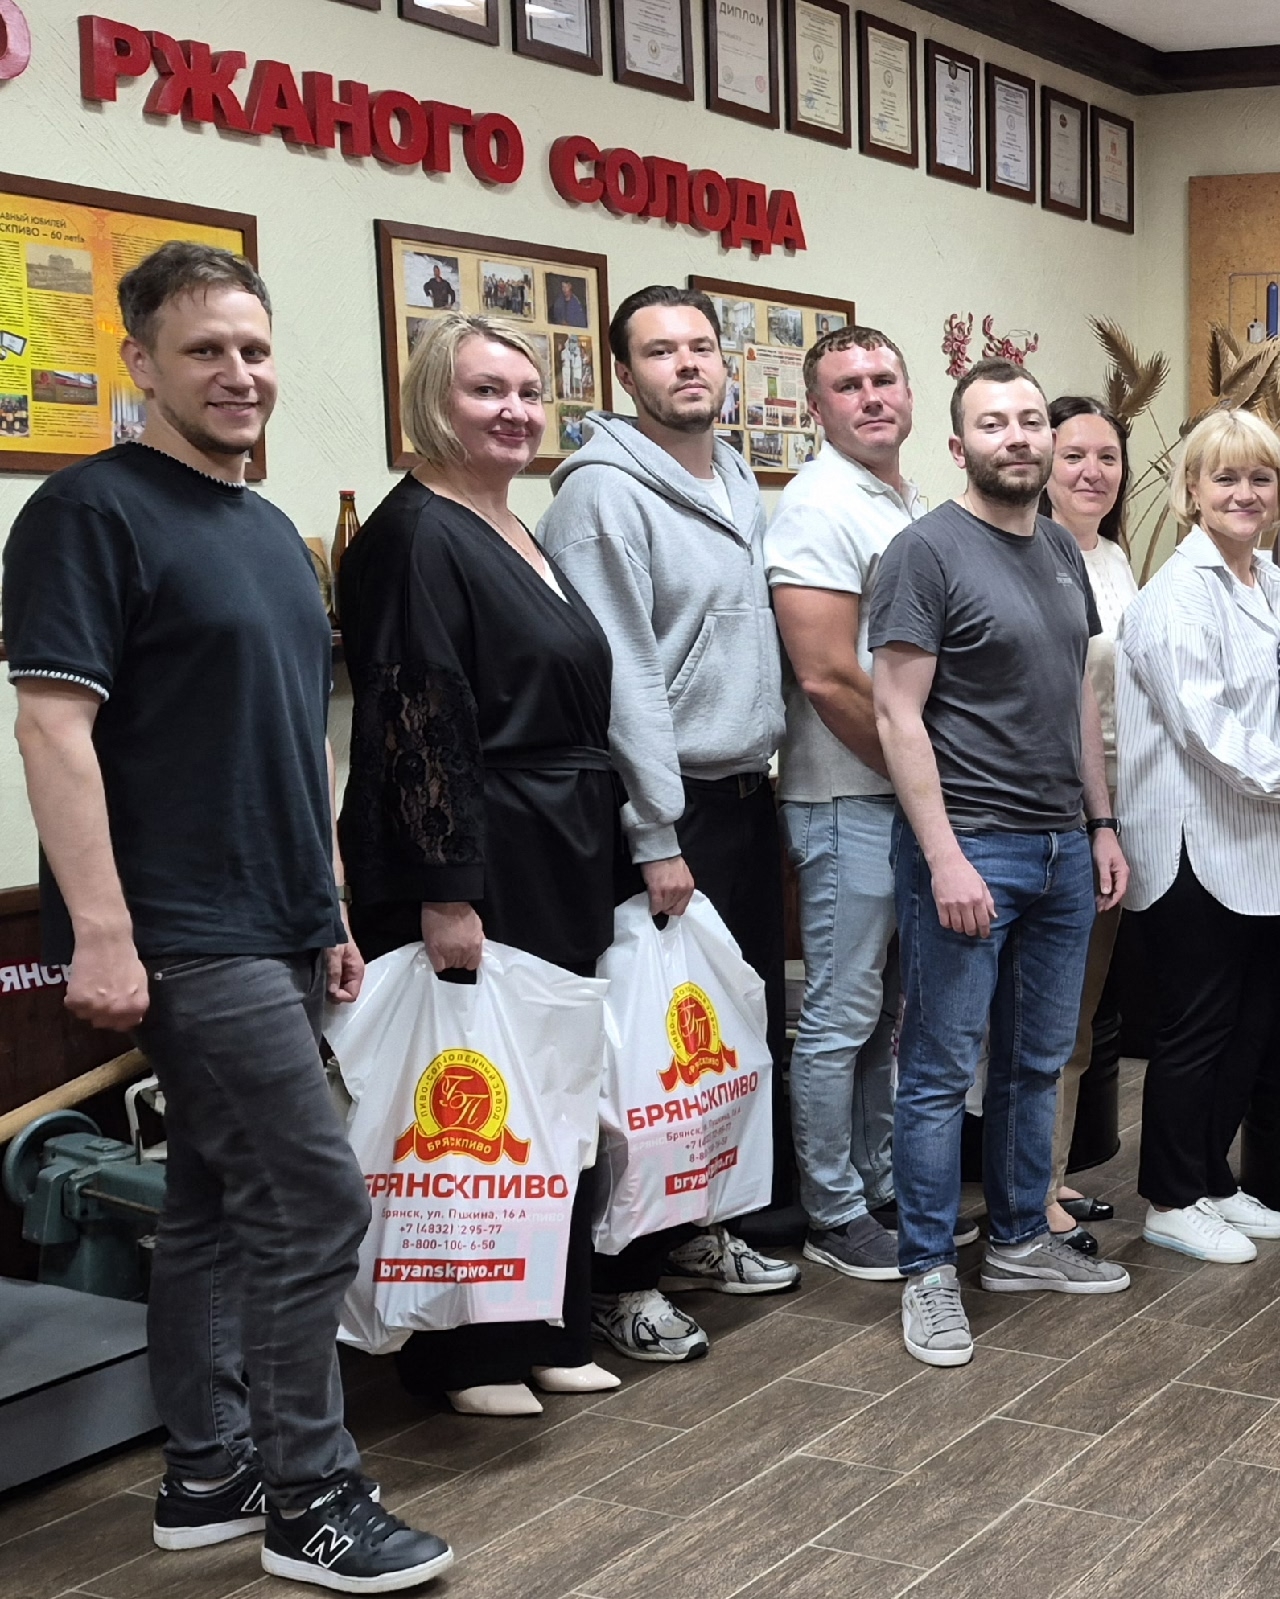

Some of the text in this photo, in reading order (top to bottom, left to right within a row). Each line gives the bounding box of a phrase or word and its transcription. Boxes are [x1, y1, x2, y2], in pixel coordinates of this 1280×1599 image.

[719, 1, 764, 27] ДИПЛОМ
[78, 14, 524, 184] РЖАНОГО
[549, 134, 807, 252] СОЛОДА
[31, 216, 66, 229] ЮБИЛЕЙ
[51, 231, 62, 240] 60
[627, 1071, 758, 1131] БРЯНСКПИВО
[428, 1209, 444, 1219] ул.
[503, 1209, 515, 1218] 16
[519, 1209, 526, 1218] А
[416, 1222, 454, 1235] (4832)
[380, 1262, 514, 1281] bryanskpivo.ru
